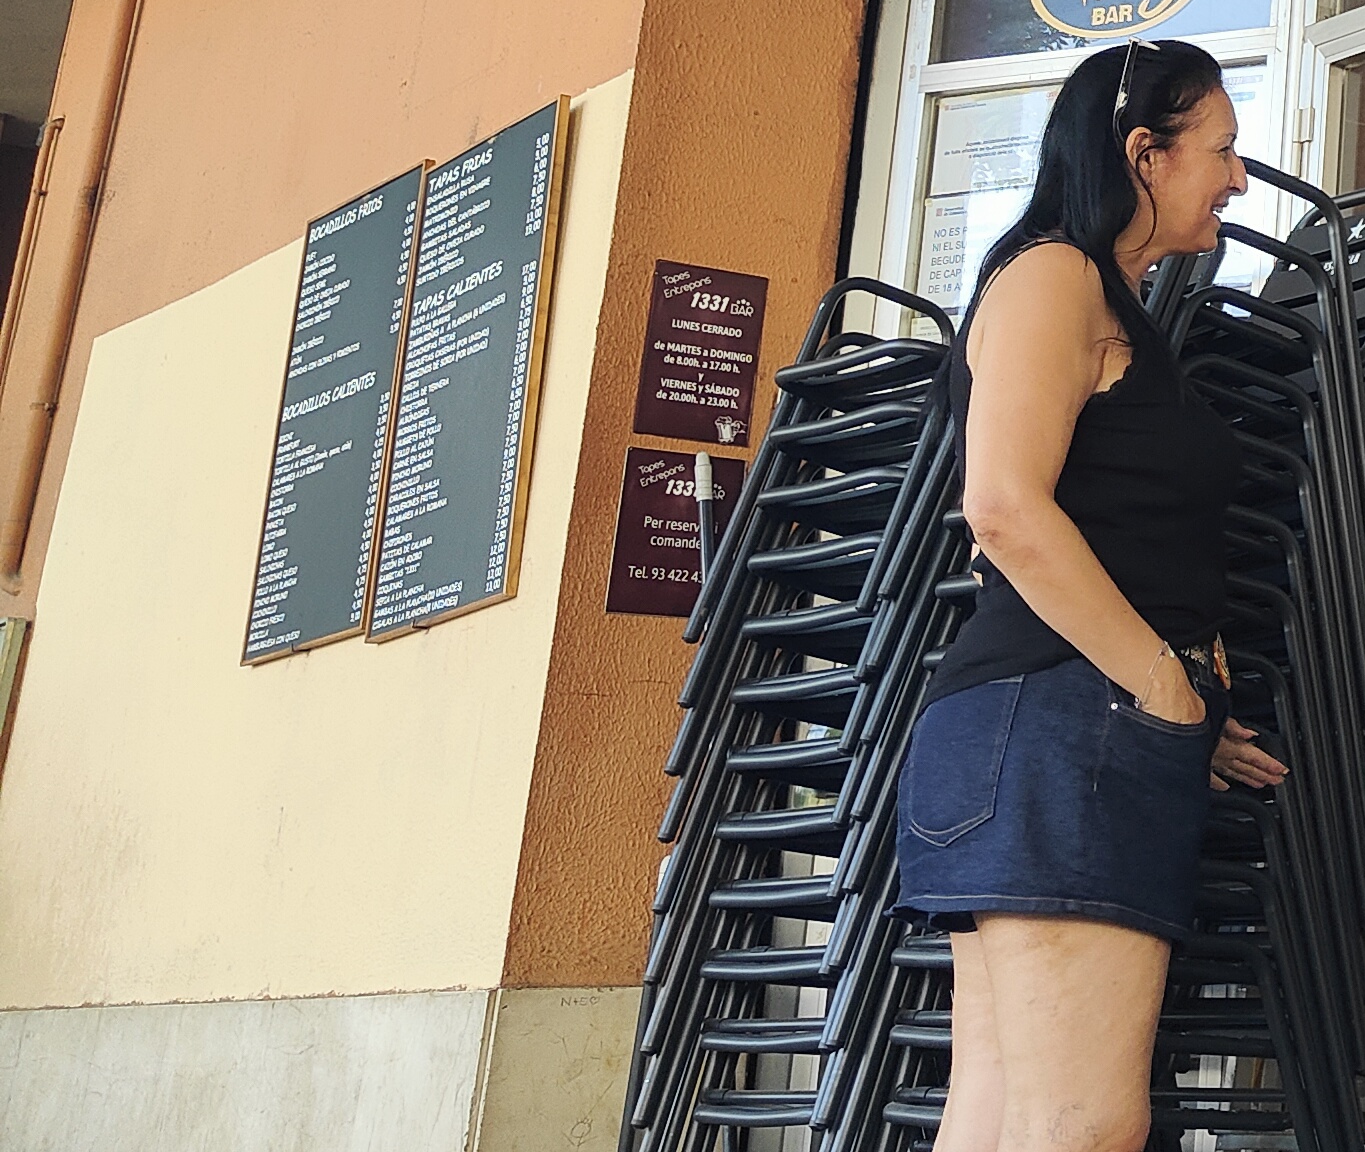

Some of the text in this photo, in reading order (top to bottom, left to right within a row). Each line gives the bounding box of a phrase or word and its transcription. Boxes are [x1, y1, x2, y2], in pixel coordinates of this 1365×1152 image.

[1091, 4, 1133, 26] BAR
[429, 148, 493, 193] TAPAS FRIAS
[309, 195, 383, 244] BOCADILLOS FRIOS
[934, 228, 947, 239] NO
[931, 253, 966, 267] BEGUDE
[662, 270, 691, 287] Tapes
[930, 270, 942, 280] DE
[412, 260, 503, 317] TAPAS CALIENTES
[663, 275, 713, 299] Entrepans
[928, 284, 941, 294] DE
[690, 292, 754, 317] 1331 BAR
[672, 318, 742, 338] LUNES CERRADO
[654, 340, 753, 363] de MARTES a DOMINGO
[663, 354, 675, 364] de
[702, 361, 708, 369] a
[709, 361, 732, 372] 17.00
[661, 377, 740, 397] VIERNES y SÁBADO
[698, 373, 704, 382] y
[282, 371, 376, 423] BOCADILLOS CALIENTES
[656, 389, 668, 400] de
[699, 397, 706, 405] a
[706, 396, 730, 408] 23.00
[638, 459, 666, 475] Tapes
[639, 463, 686, 488] Entrepans
[665, 479, 697, 498] 133
[643, 515, 664, 529] Per
[650, 535, 701, 550] comande
[628, 565, 649, 580] Tel.
[651, 567, 666, 581] 93
[667, 569, 689, 583] 422
